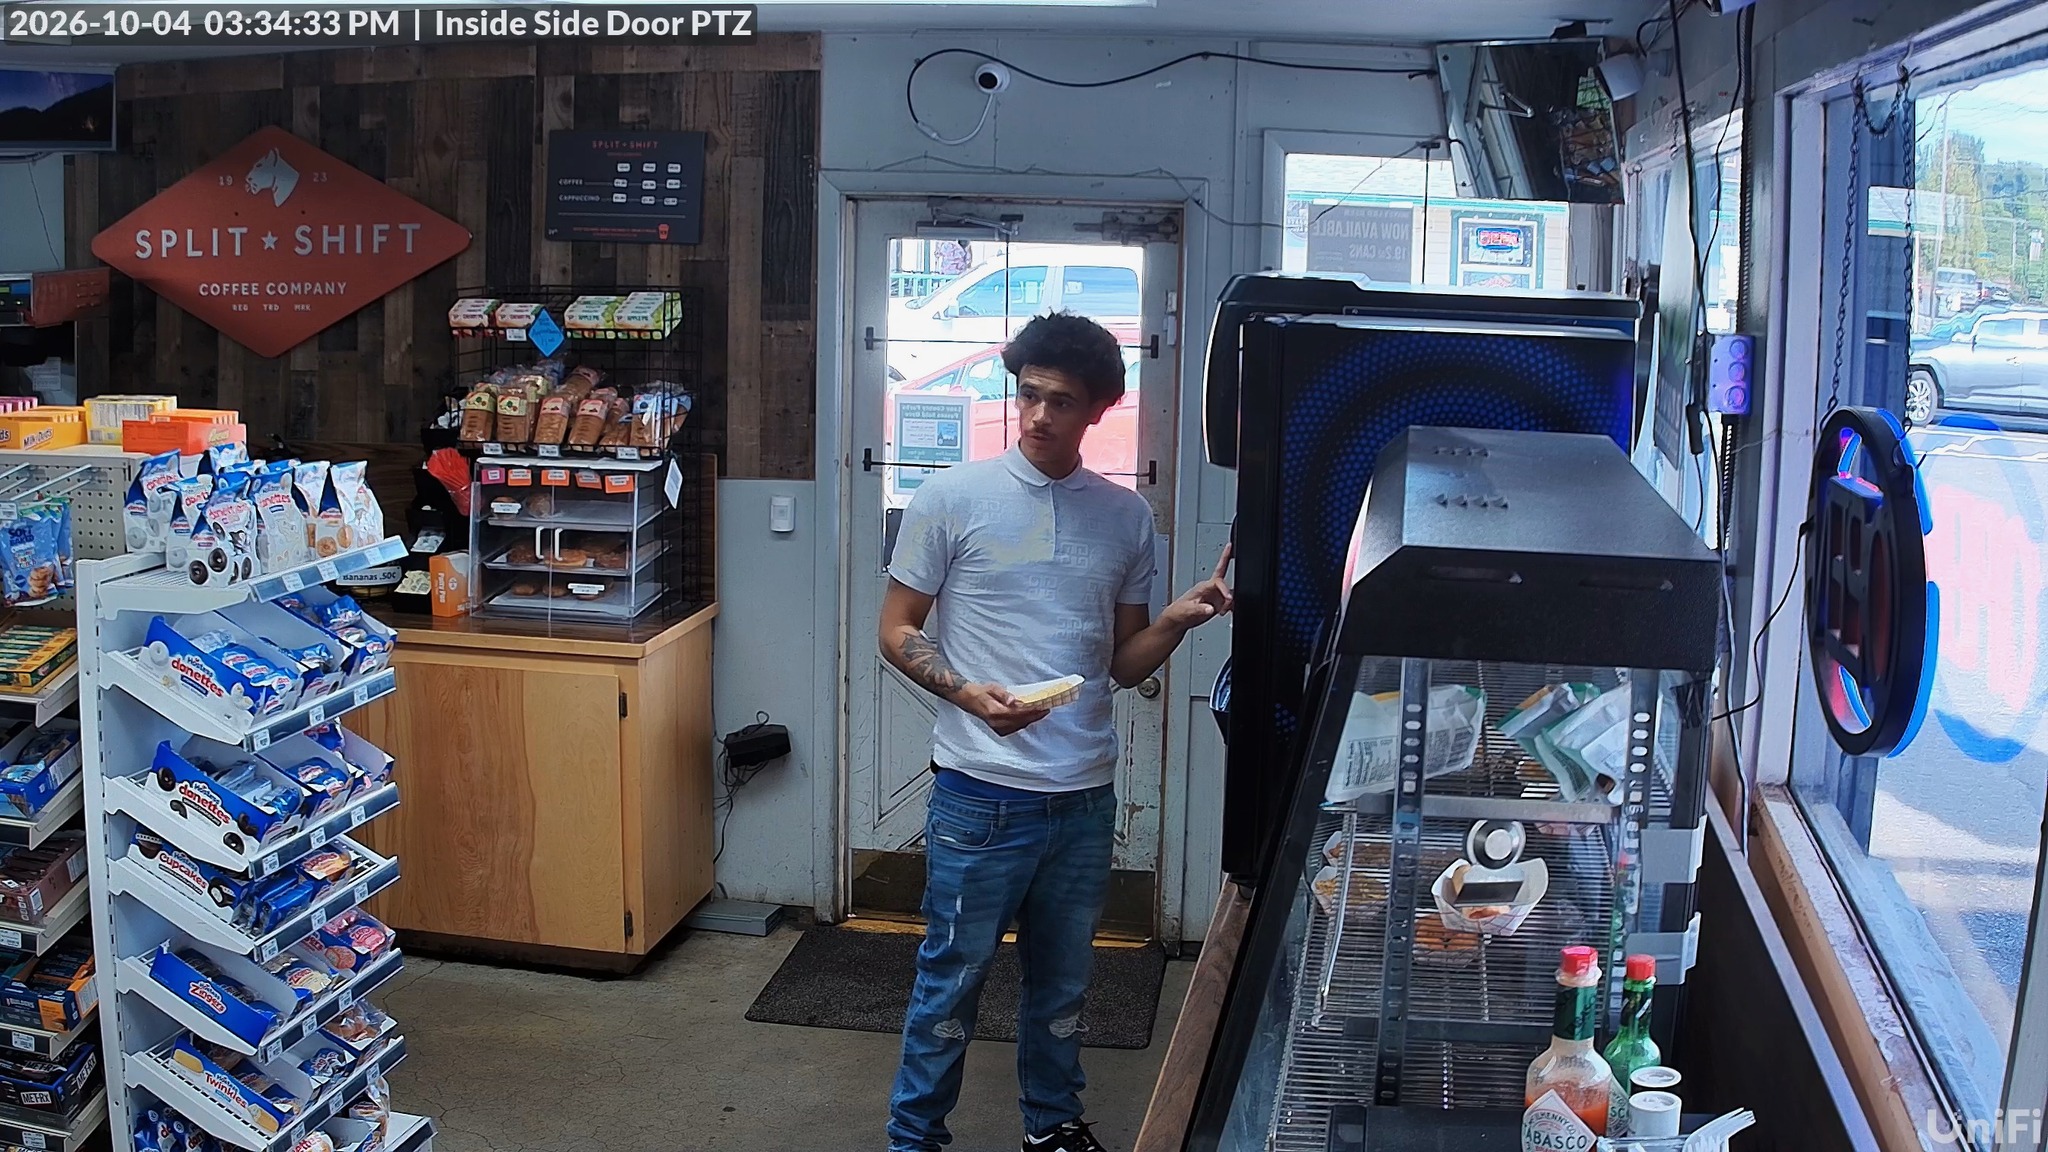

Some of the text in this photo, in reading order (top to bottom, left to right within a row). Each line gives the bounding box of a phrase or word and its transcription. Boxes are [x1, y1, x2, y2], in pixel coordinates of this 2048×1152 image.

[218, 175, 234, 186] 19
[312, 172, 328, 183] 23
[135, 223, 421, 259] SPLIT SHIFT
[199, 281, 347, 297] COFFEE COMPANY
[231, 303, 249, 312] REG
[262, 303, 280, 312] TRD
[171, 657, 225, 698] donettes
[178, 784, 231, 824] donettes
[159, 852, 208, 889] Cupcakes
[190, 984, 225, 1013] Zingers
[22, 1092, 51, 1104] MET-RX
[205, 1072, 248, 1109] Twinkies
